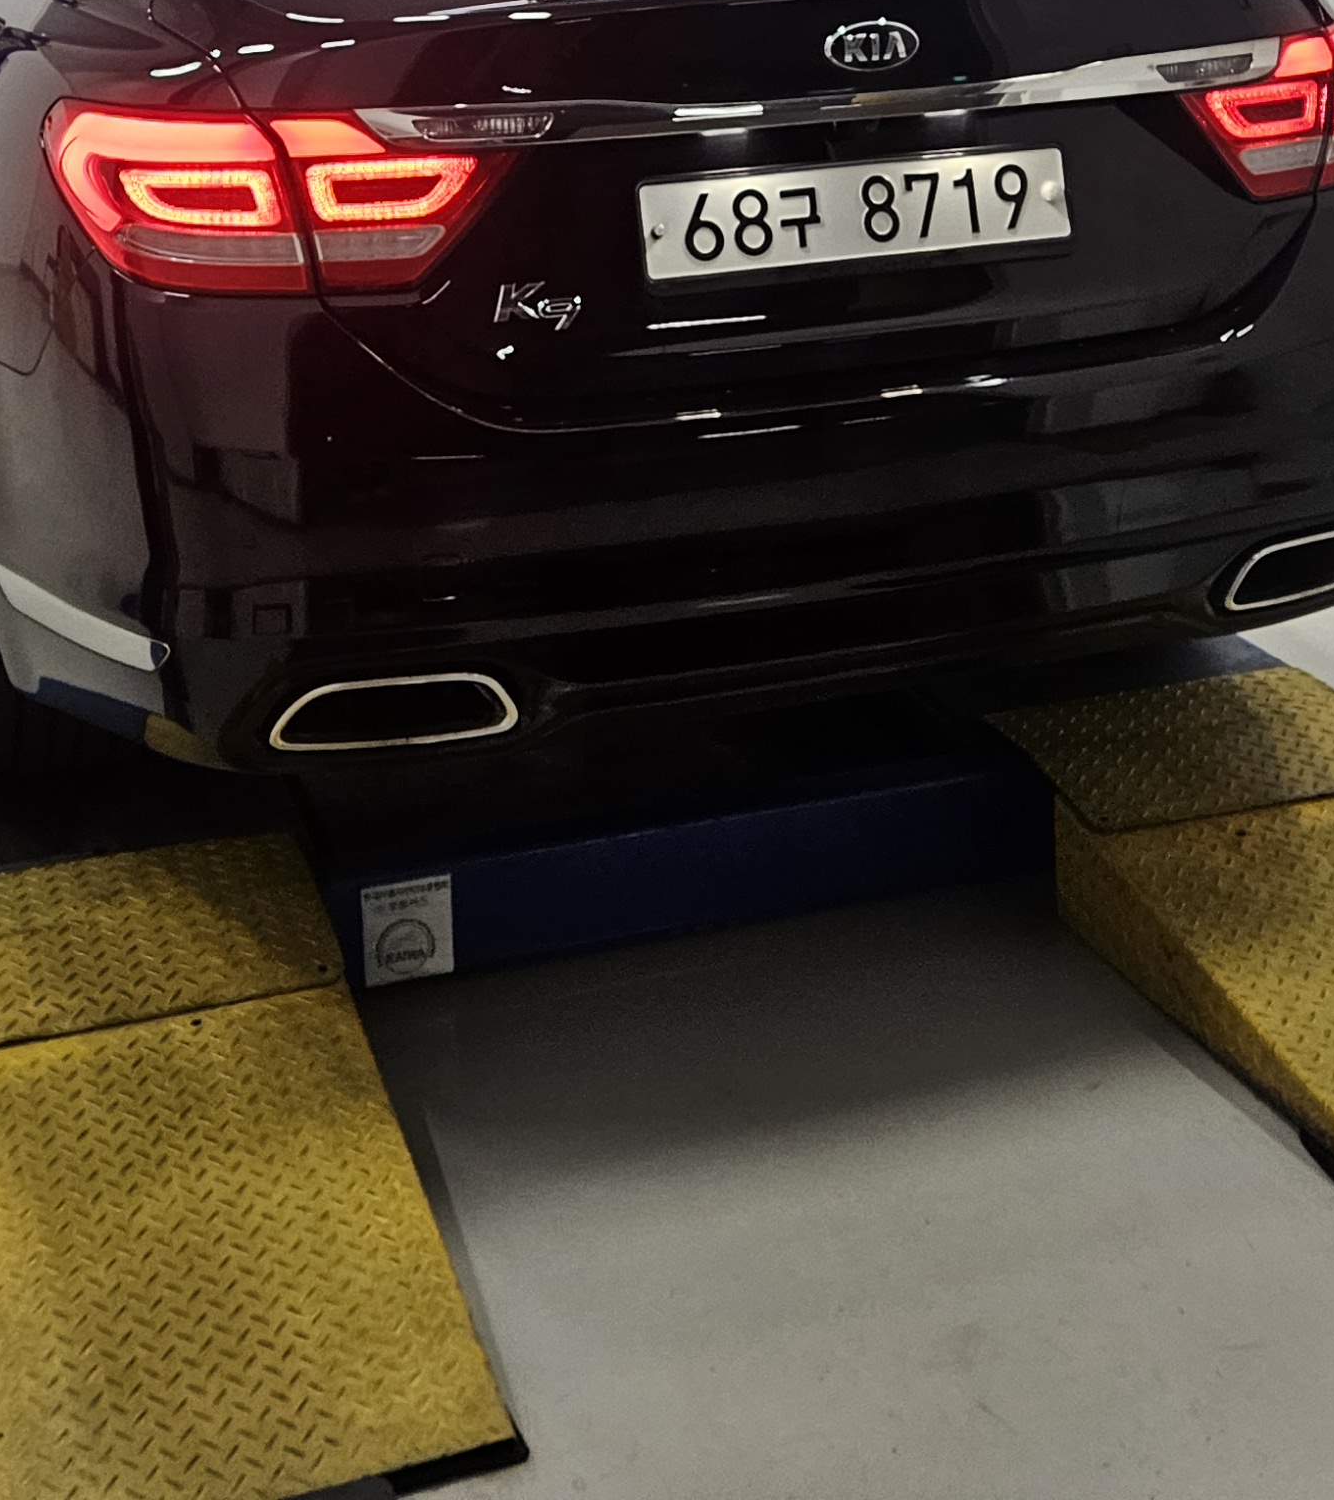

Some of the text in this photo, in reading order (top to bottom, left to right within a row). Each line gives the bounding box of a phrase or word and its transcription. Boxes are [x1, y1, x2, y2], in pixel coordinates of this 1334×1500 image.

[843, 30, 907, 63] KIA
[683, 163, 1029, 262] 68구 8719
[493, 281, 582, 331] K9
